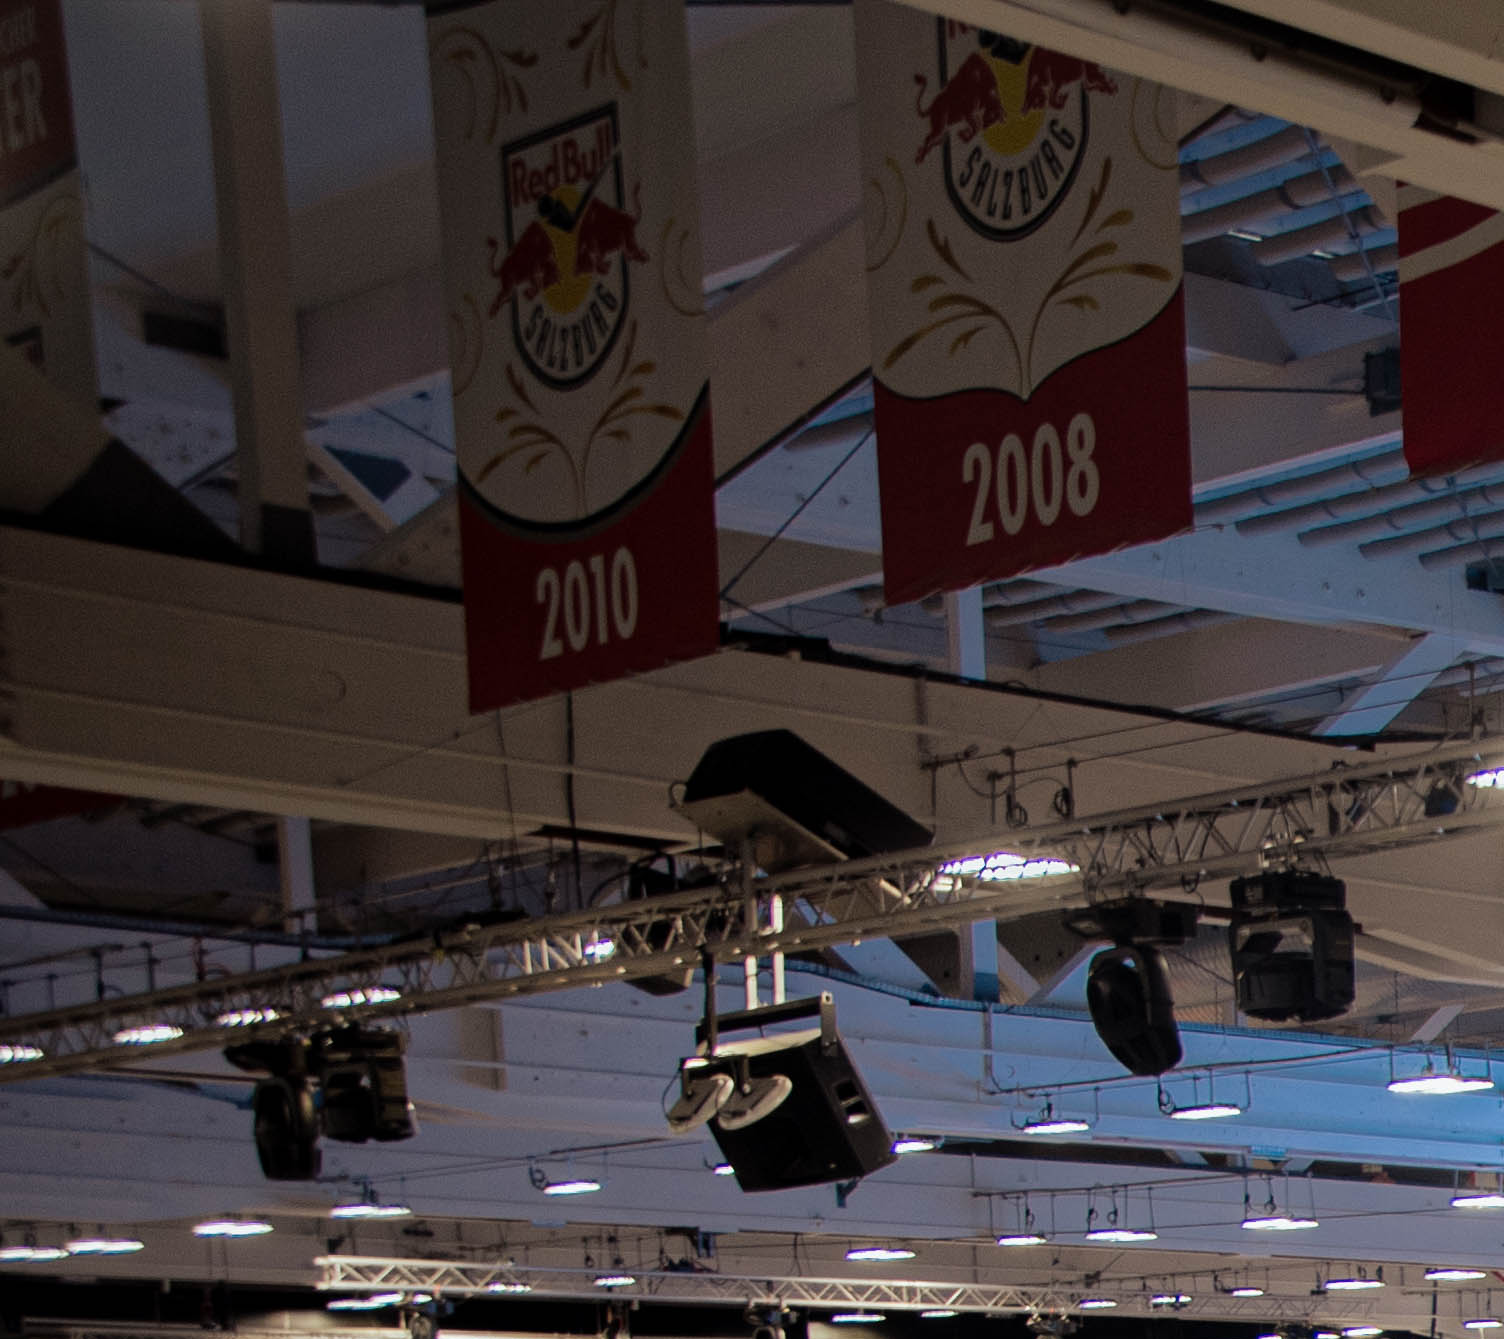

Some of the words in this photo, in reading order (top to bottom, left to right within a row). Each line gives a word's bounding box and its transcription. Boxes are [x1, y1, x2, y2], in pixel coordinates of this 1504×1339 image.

[961, 116, 1076, 221] SALZBURG
[524, 279, 620, 369] SALZBURG
[962, 412, 1100, 547] 2008
[537, 547, 638, 660] 2010
